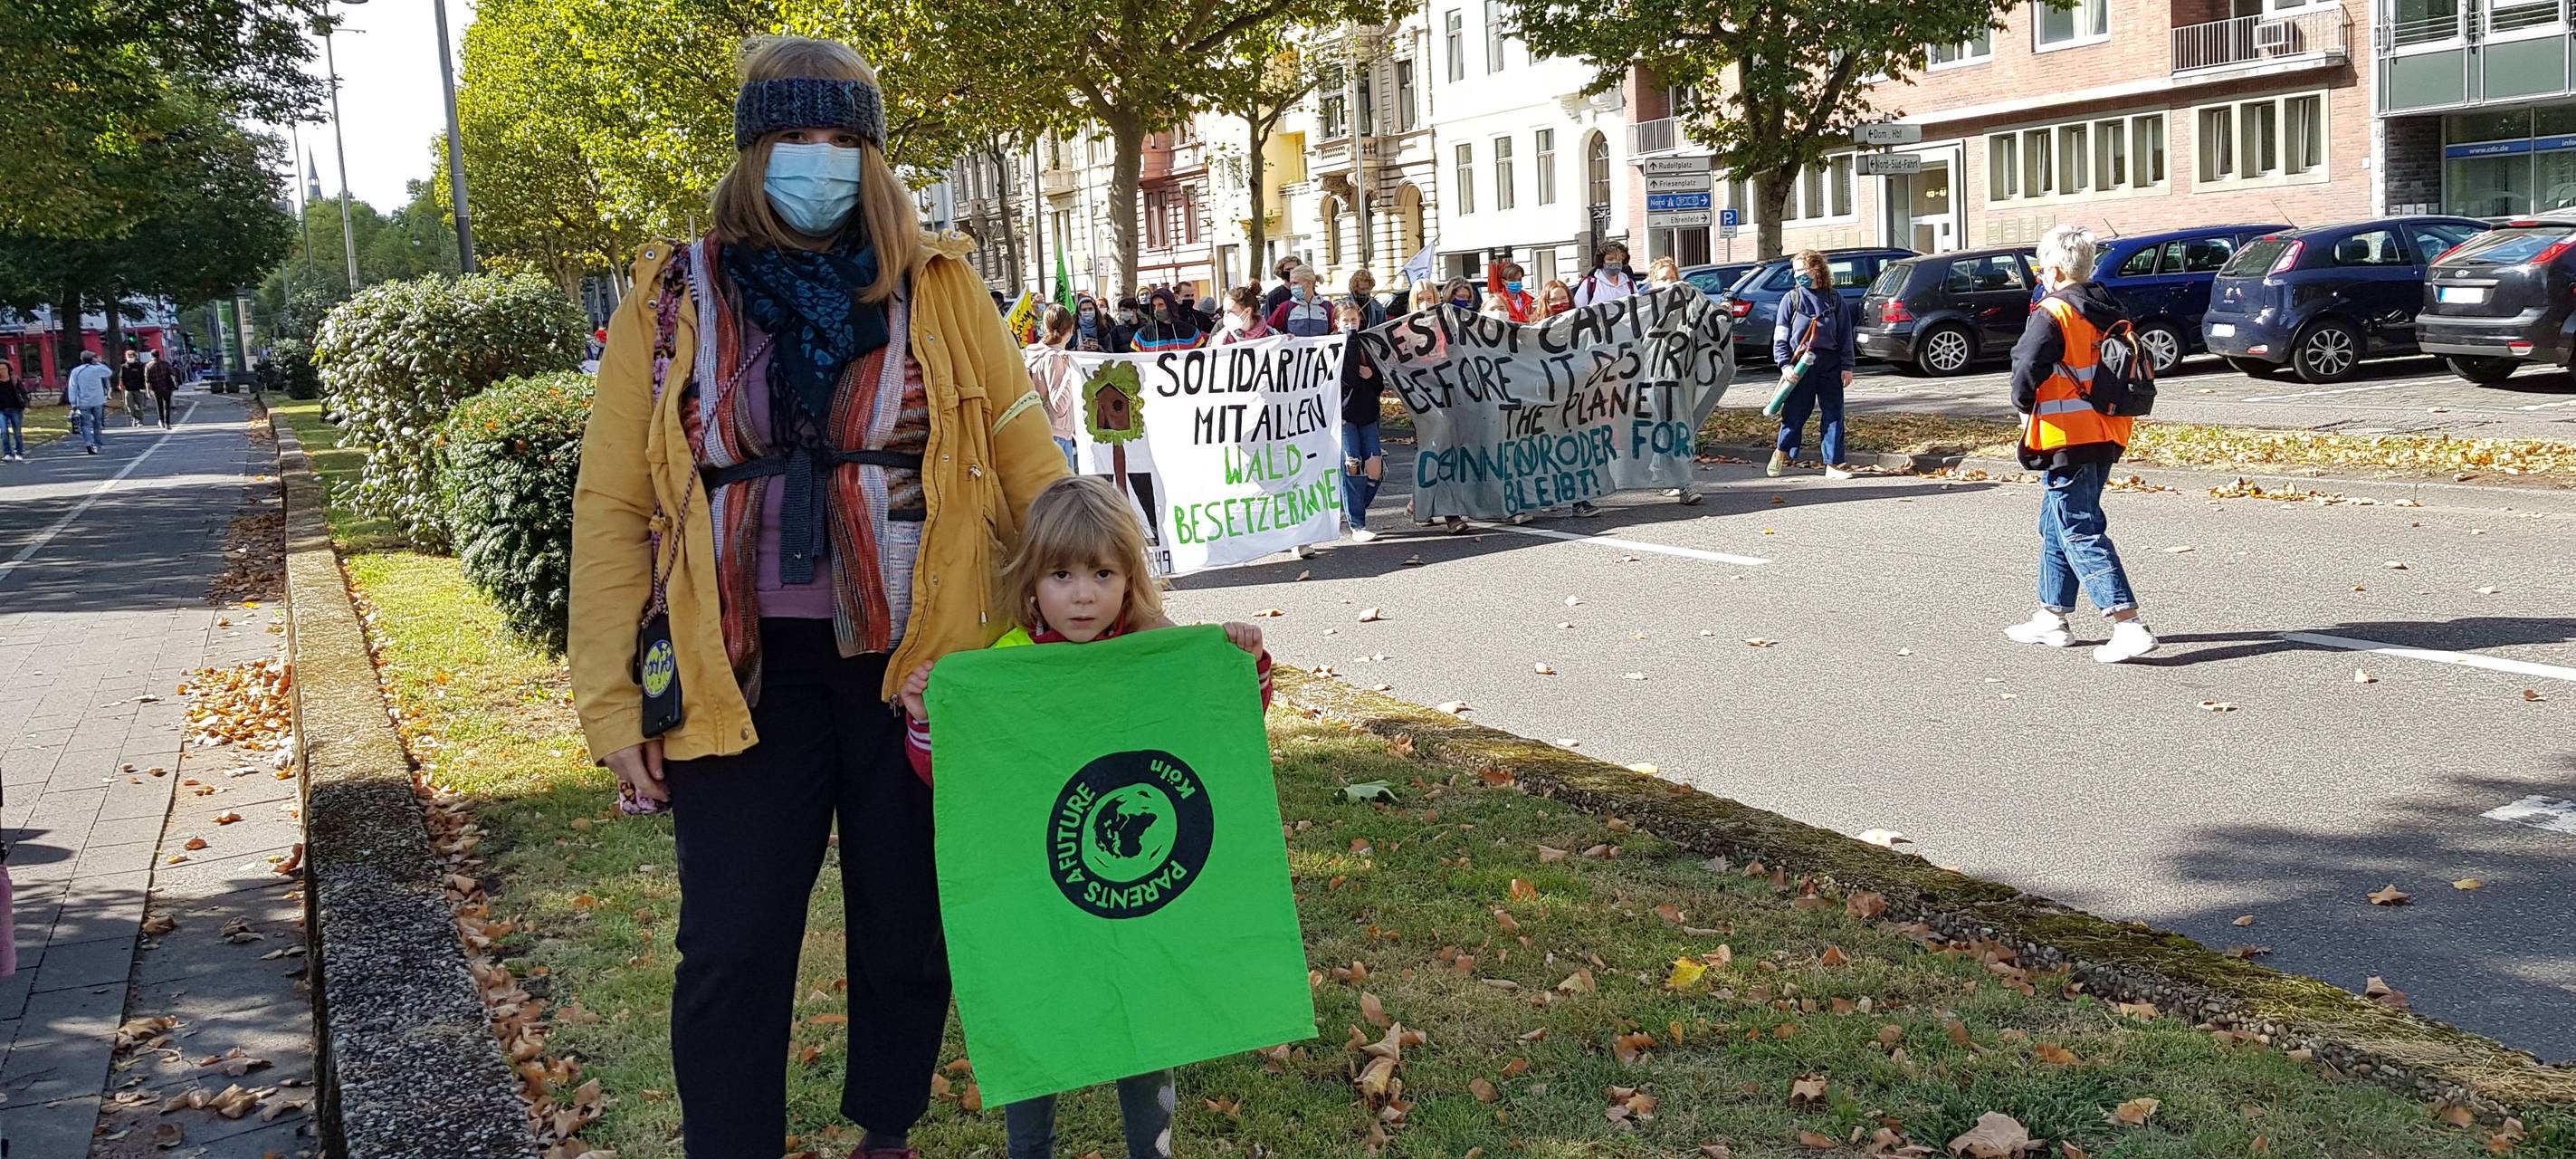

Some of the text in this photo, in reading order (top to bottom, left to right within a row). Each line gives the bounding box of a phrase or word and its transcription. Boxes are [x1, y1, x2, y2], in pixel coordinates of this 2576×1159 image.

[1658, 161, 1693, 169] Rudolfplatz
[1659, 179, 1696, 187] Friesenplatz
[1876, 158, 1918, 169] Nord-Süd-Fahrt
[1650, 198, 1665, 206] Nord
[1359, 302, 1522, 363] DESTROY
[1390, 356, 1522, 414] BEFORE
[1540, 353, 1575, 402] IT
[1194, 393, 1328, 445] MIT ALLEN
[1499, 380, 1680, 439] THE PLANET
[1632, 419, 1694, 460] FOR
[1225, 443, 1317, 485] WALD-
[1503, 468, 1601, 515] BLEIBT!
[1150, 759, 1196, 800] Köln
[1056, 781, 1188, 909] PARENTS 4 FUTURE
